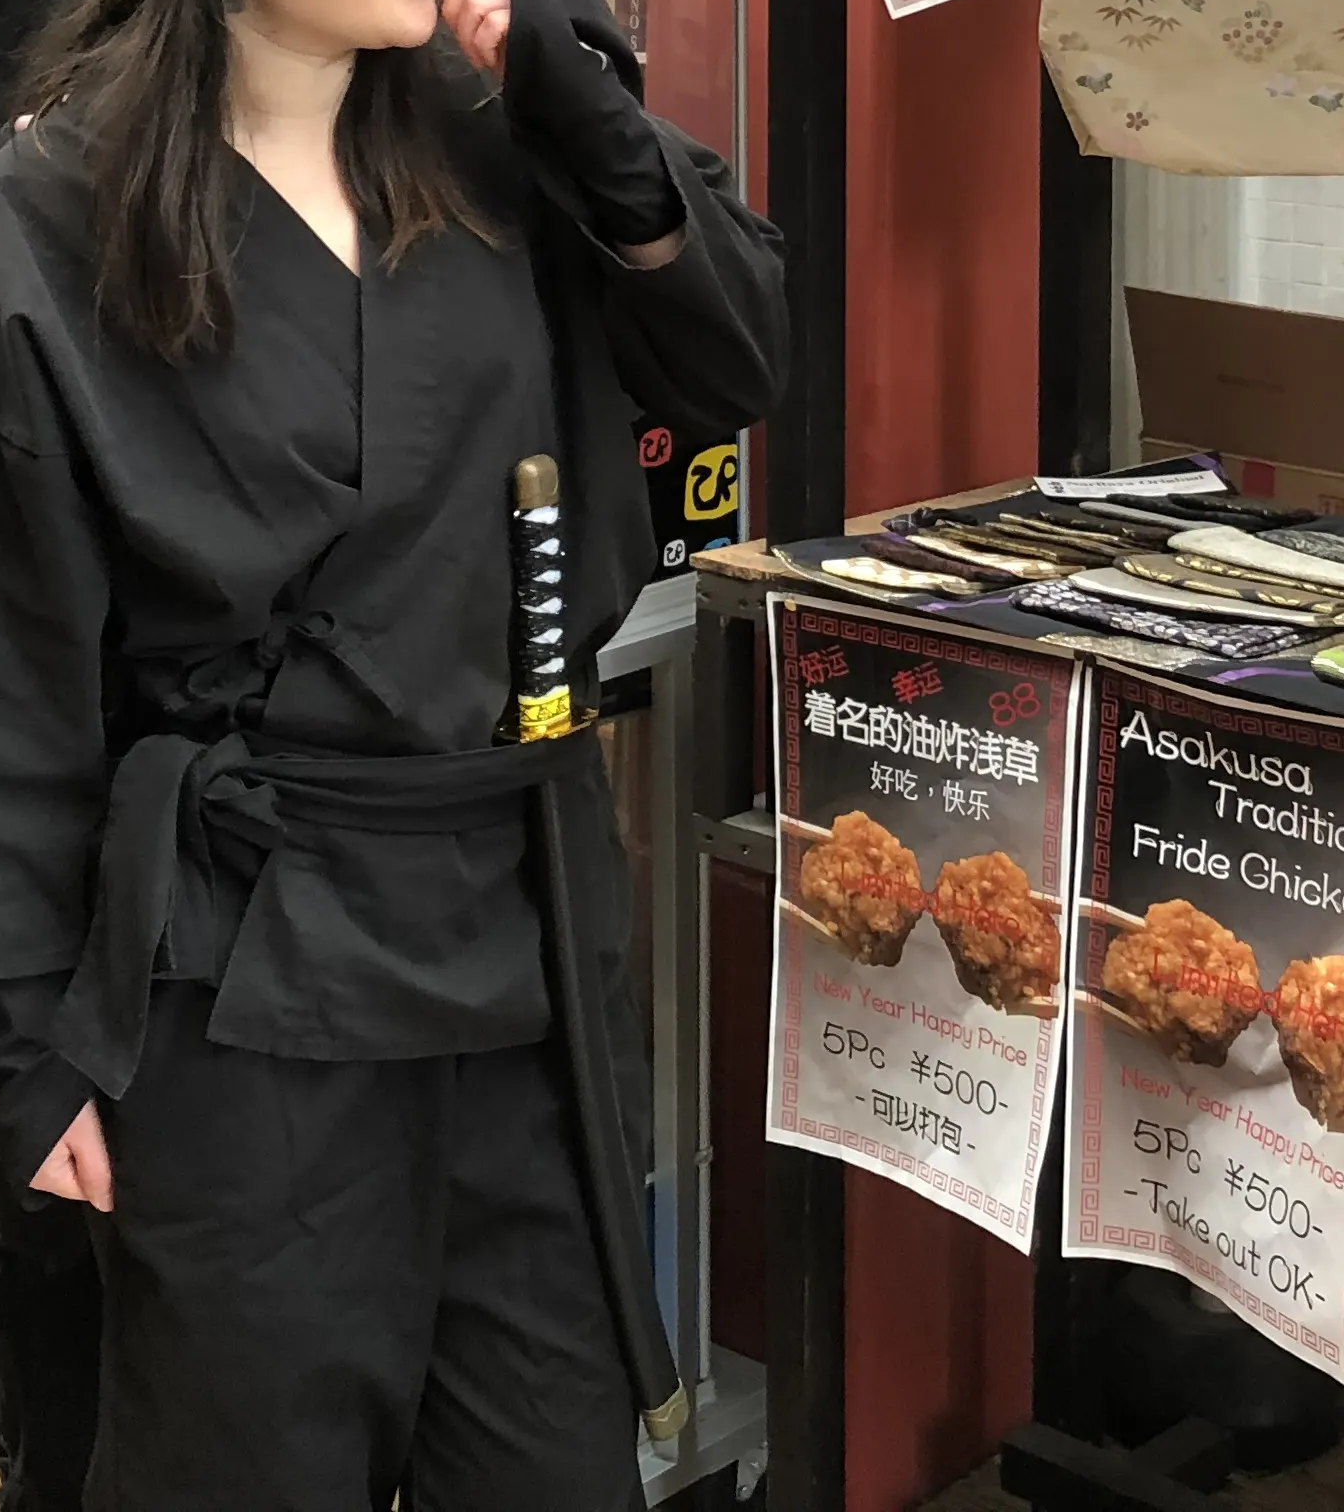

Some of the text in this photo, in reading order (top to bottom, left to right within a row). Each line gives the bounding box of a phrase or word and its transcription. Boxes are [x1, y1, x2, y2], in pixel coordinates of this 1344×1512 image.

[804, 688, 1040, 787] 着名的油炸浅草
[988, 682, 1041, 727] 88
[1119, 710, 1314, 797] Asakusa
[1131, 822, 1231, 880] Fride
[813, 971, 1028, 1067] New Year Happy Price
[1120, 1065, 1171, 1100] New
[1181, 1085, 1233, 1123] Year
[1235, 1104, 1296, 1165] Happy
[1215, 1231, 1261, 1278] out
